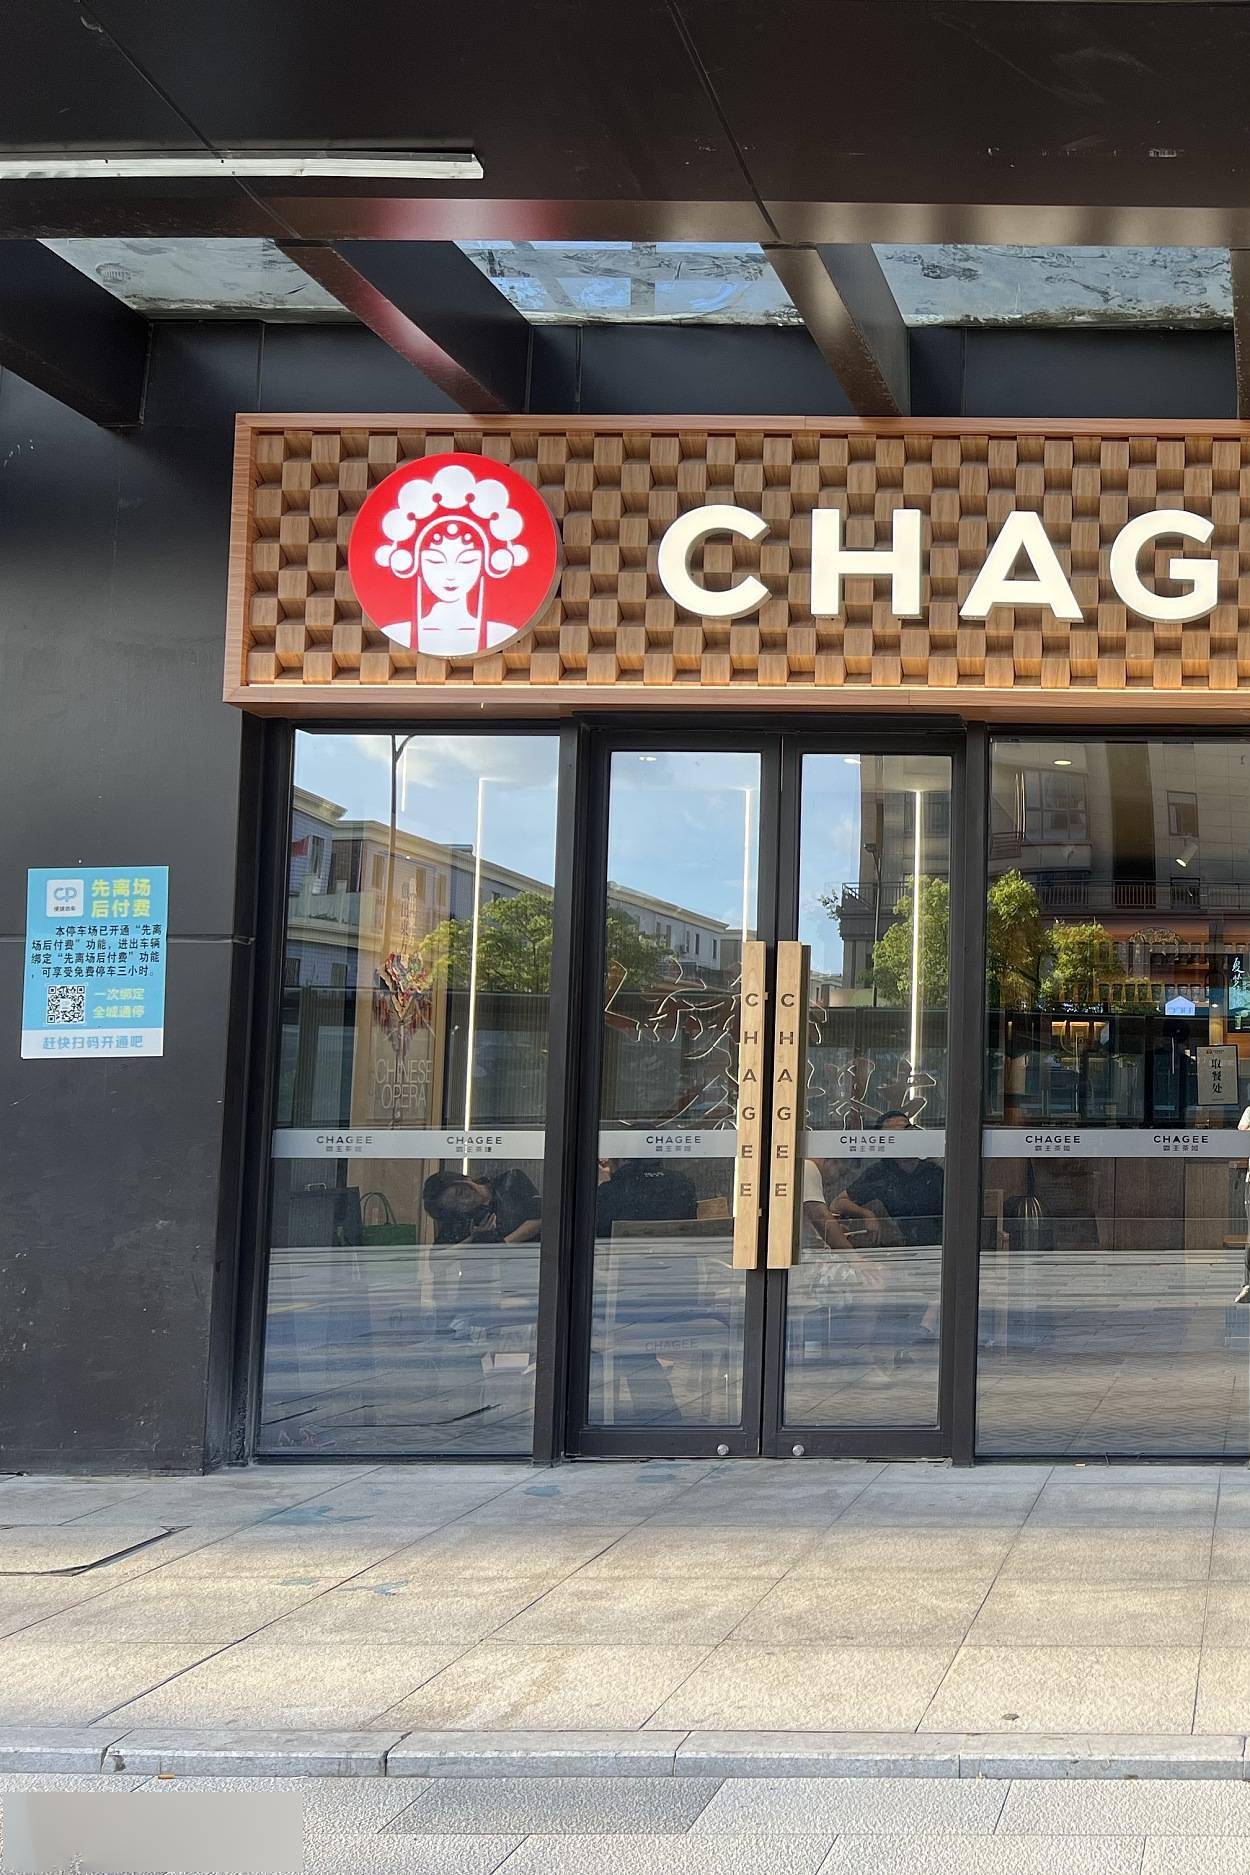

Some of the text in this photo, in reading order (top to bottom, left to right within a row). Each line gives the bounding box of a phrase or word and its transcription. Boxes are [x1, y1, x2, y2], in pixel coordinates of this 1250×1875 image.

[91, 878, 151, 897] 先离场
[91, 899, 151, 918] 后付费
[42, 1035, 145, 1050] 赶快扫码开通吧
[375, 1058, 432, 1083] CHINESE
[1211, 1058, 1223, 1094] 取餐处
[381, 1084, 427, 1108] OPERA
[739, 993, 760, 1197] CHAGEE
[774, 993, 795, 1197] CHAGEE
[316, 1135, 373, 1145] CHAGEE
[447, 1136, 503, 1145] CHAGEE
[646, 1135, 702, 1144] CHAGEE
[840, 1135, 896, 1145] CHAGEE
[1025, 1135, 1081, 1144] CHAGEE
[1153, 1135, 1209, 1144] CHAGEE
